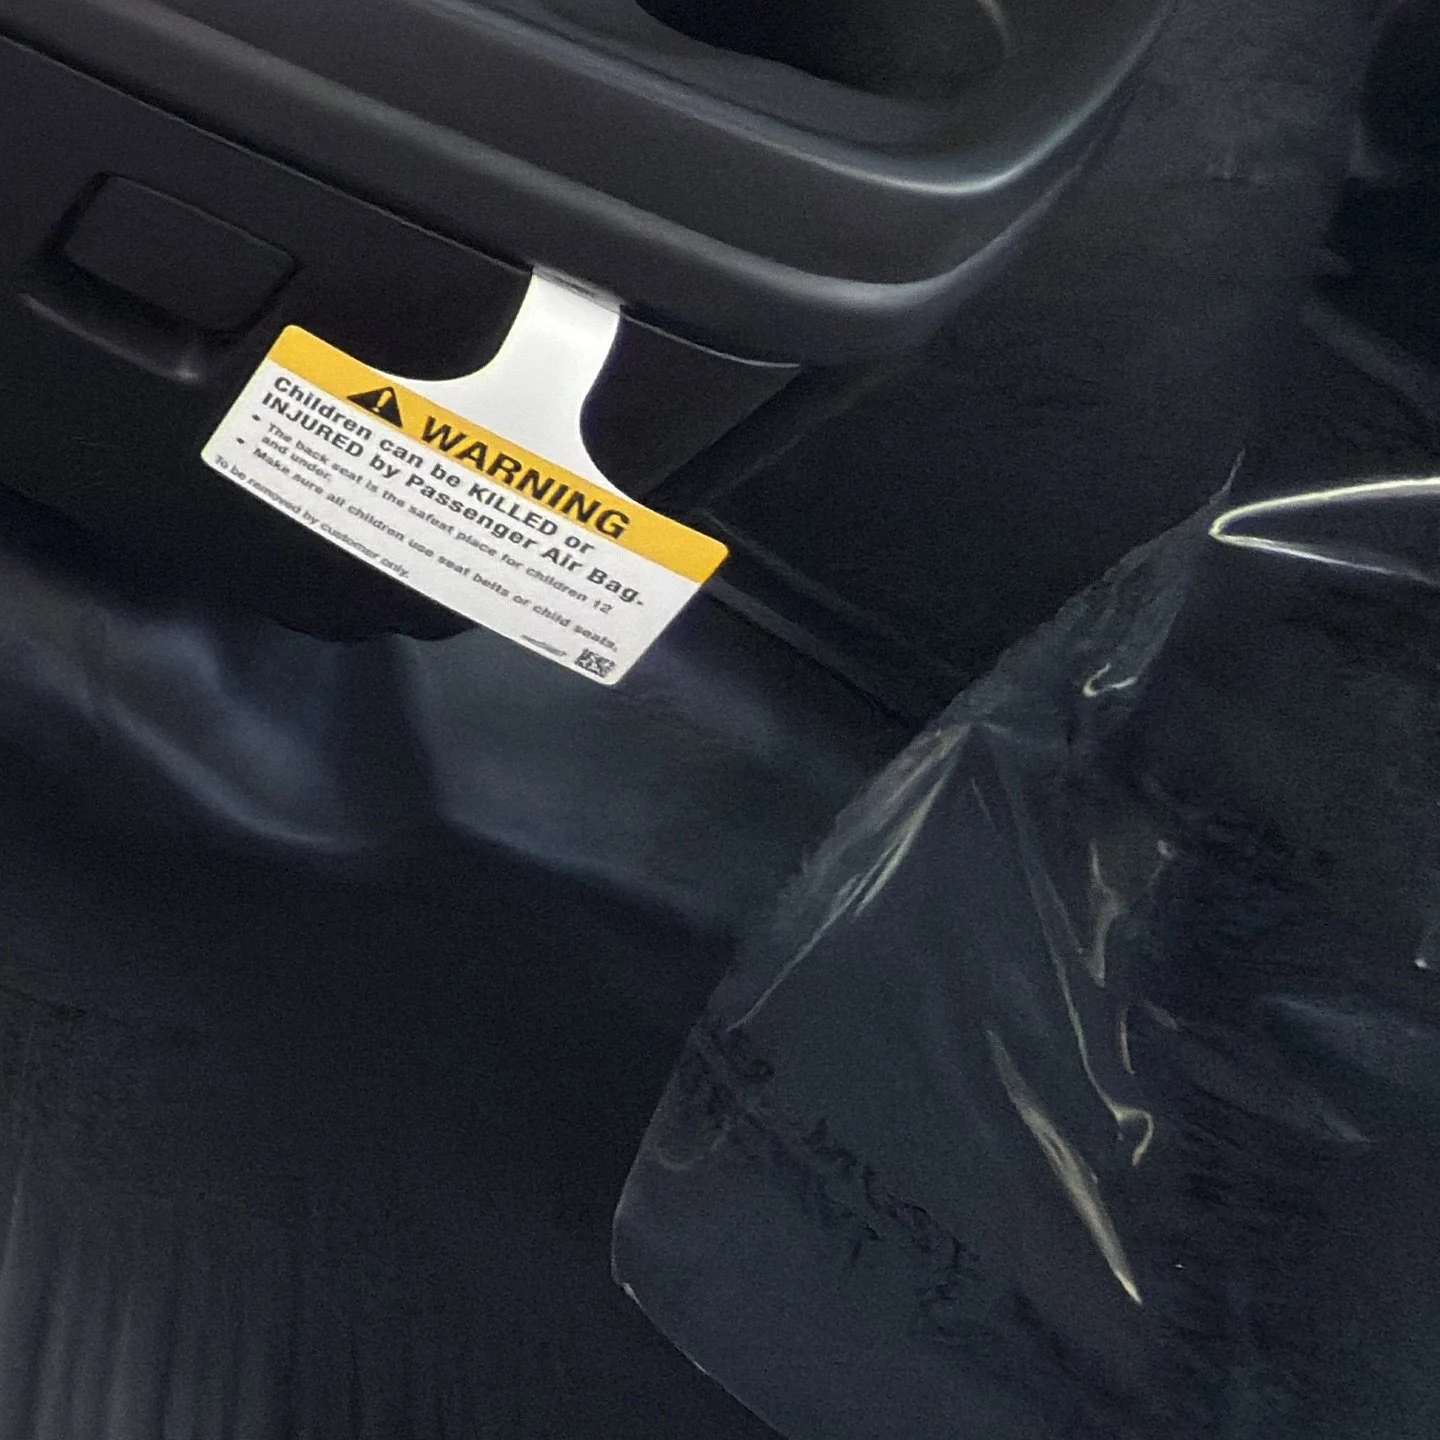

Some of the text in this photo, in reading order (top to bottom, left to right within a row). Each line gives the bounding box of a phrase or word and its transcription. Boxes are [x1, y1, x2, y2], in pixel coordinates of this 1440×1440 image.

[214, 454, 229, 470] To
[230, 466, 246, 482] be
[247, 477, 302, 515] removed
[302, 511, 320, 526] by
[320, 522, 381, 560] customer
[261, 435, 288, 455] and
[262, 392, 364, 457] INJURED
[369, 454, 400, 479] by
[405, 473, 538, 549] Passenger
[541, 547, 584, 571] Air
[268, 422, 613, 615] The back seat is the safest place for children 12
[273, 376, 596, 554] Children can be KILLED or
[421, 416, 630, 540] WARNING
[253, 447, 291, 475] Make
[292, 474, 324, 496] sure
[326, 492, 347, 509] all
[348, 504, 405, 542] children
[408, 538, 435, 558] use
[437, 554, 471, 577] seat
[472, 572, 510, 598] belts
[512, 594, 530, 607] or
[533, 604, 571, 628] child
